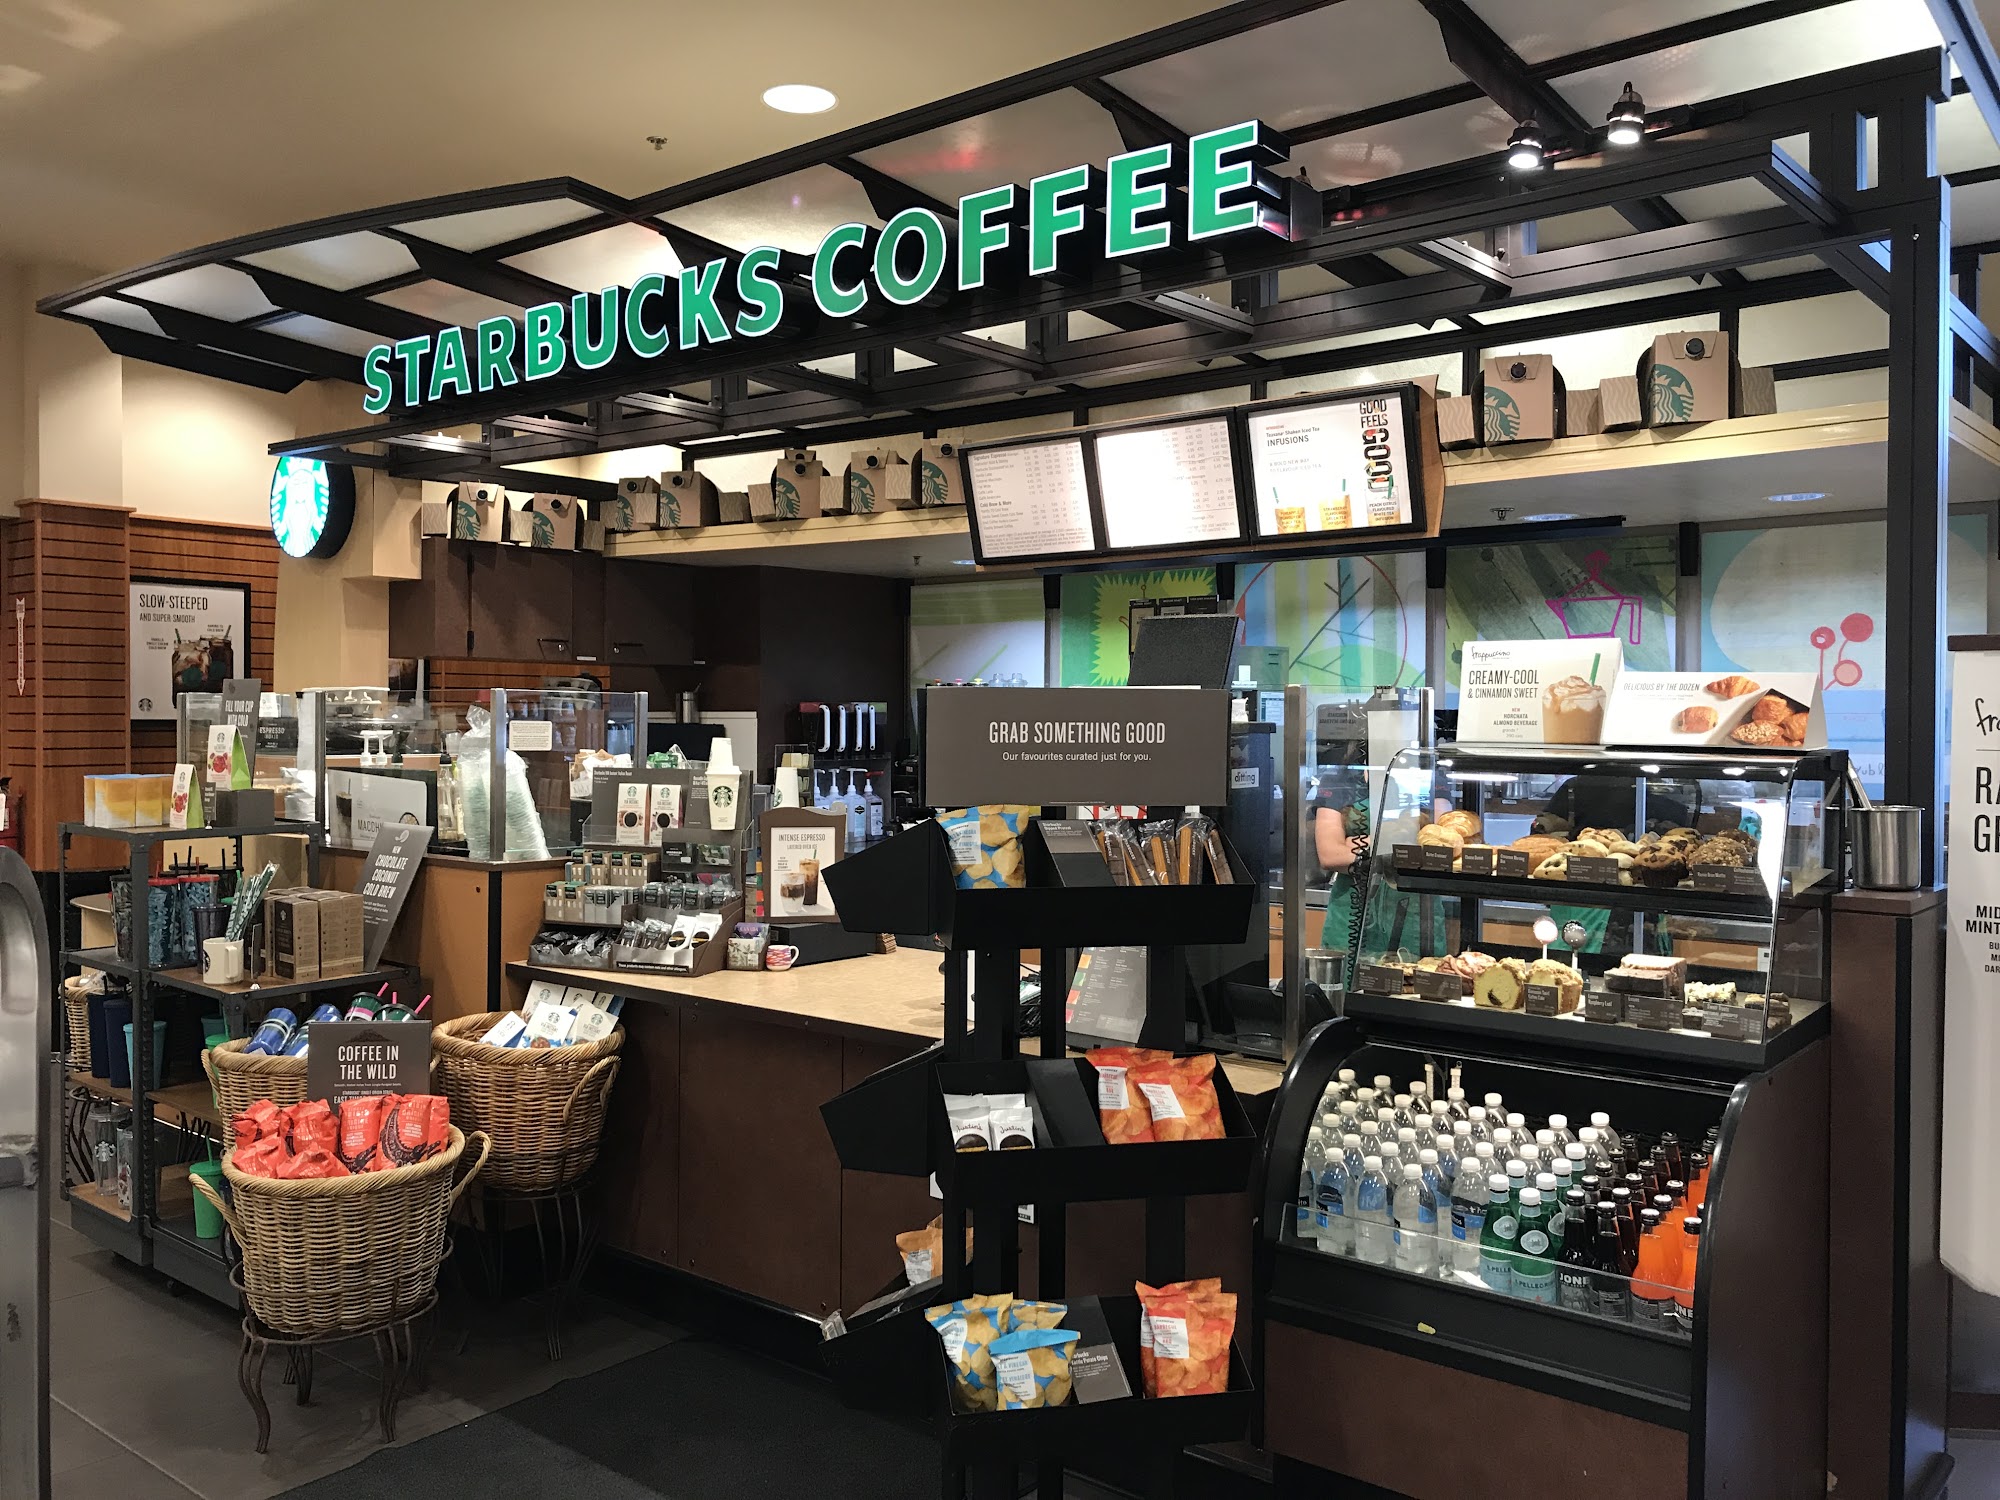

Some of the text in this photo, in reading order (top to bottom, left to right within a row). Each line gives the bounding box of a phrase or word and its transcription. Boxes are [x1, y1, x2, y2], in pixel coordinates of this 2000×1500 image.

[362, 119, 1260, 415] STARBUCKS COFFEE
[1360, 399, 1387, 415] GOOD
[1361, 414, 1388, 428] FEELS
[1267, 435, 1309, 446] INFUSIONS
[1362, 427, 1394, 493] GOOD
[139, 593, 208, 611] SLOW-STEEPED
[139, 613, 196, 623] AND SUPER SMOOTH
[1471, 646, 1510, 661] frappuccino
[1469, 670, 1539, 685] CREAMY-COOL
[1468, 688, 1538, 698] & CINNAMON SWEET
[1679, 683, 1700, 691] DOZEN
[245, 701, 254, 713] CUP
[238, 715, 249, 727] COLD
[989, 721, 1166, 744] GRAB SOMETHING GOOD
[1002, 752, 1151, 762] Our favourites curated just for you.
[392, 846, 402, 854] NEW
[375, 854, 409, 870] CHOCOLATE
[372, 868, 400, 884] COCONUT
[363, 882, 397, 899] COLD BREW
[1966, 920, 2000, 934] MINT
[338, 1046, 399, 1061] COFFEE IN
[340, 1064, 397, 1080] THE WILD
[334, 1096, 347, 1104] EAST
